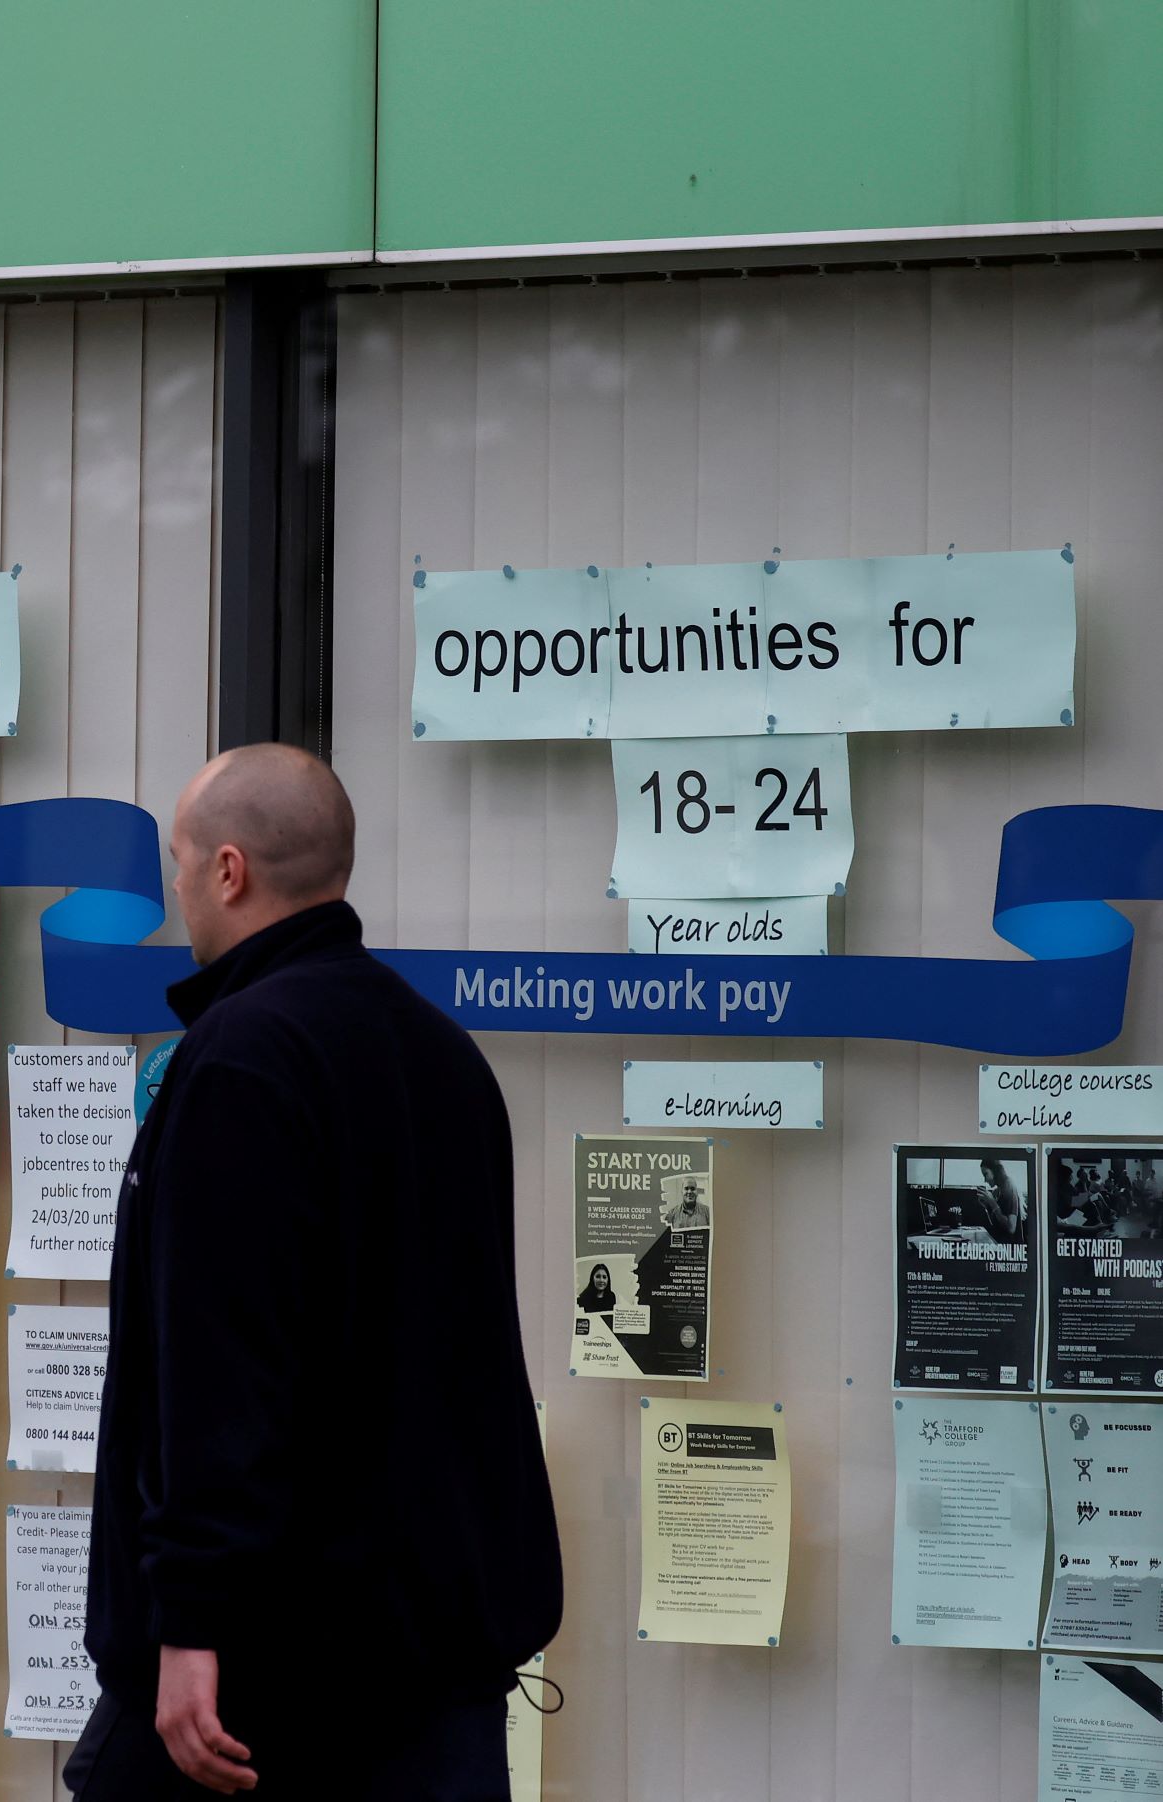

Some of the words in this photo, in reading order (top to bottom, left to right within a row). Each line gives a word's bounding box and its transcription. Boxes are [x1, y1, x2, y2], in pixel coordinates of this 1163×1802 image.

[435, 606, 839, 692] opportunities
[889, 601, 974, 666] for
[640, 769, 735, 835] 18-
[754, 767, 828, 831] 24
[647, 911, 720, 952] Year
[727, 910, 783, 943] olds
[454, 967, 595, 1020] Making
[608, 968, 706, 1010] work
[719, 978, 791, 1023] pay
[15, 1053, 83, 1066] customers
[87, 1051, 109, 1066] and
[113, 1054, 132, 1066] our
[33, 1078, 62, 1092] staff
[67, 1080, 85, 1092] we
[90, 1078, 116, 1092] have
[997, 1069, 1072, 1096] College
[1079, 1072, 1153, 1091] courses
[18, 1104, 54, 1118] taken
[58, 1105, 79, 1118] the
[83, 1105, 131, 1119] decision
[664, 1092, 782, 1126] e-learning
[997, 1105, 1072, 1127] on-line
[40, 1132, 53, 1144] to
[57, 1131, 88, 1145] close
[93, 1134, 113, 1145] our
[23, 1156, 89, 1173] jobcentres
[93, 1159, 105, 1172] to
[109, 1157, 127, 1172] the
[587, 1152, 642, 1169] START
[647, 1153, 691, 1171] YOUR
[587, 1173, 651, 1191] FUTURE
[41, 1184, 78, 1200] public
[82, 1184, 111, 1198] from
[32, 1209, 89, 1226] 24/03/20
[93, 1211, 116, 1224] unti
[31, 1235, 74, 1251] further
[78, 1236, 115, 1251] notice
[1057, 1239, 1076, 1257] GET
[1078, 1239, 1122, 1258] STARTED
[918, 1241, 955, 1259] FUTURE
[956, 1243, 996, 1261] LEADERS
[997, 1244, 1027, 1262] ONLINE
[1094, 1259, 1119, 1277] WITH
[1123, 1260, 1163, 1278] PODCAS
[26, 1331, 36, 1339] TO
[39, 1331, 64, 1340] CLAIM
[67, 1332, 109, 1342] UNIVERSA
[46, 1364, 69, 1375] 0800
[73, 1365, 90, 1376] 328
[26, 1390, 62, 1399] CITIZENS
[65, 1390, 94, 1400] ADVICE
[26, 1401, 43, 1411] Help
[45, 1402, 51, 1410] to
[54, 1402, 72, 1411] claim
[26, 1428, 48, 1439] 0800
[52, 1429, 68, 1440] 144
[72, 1430, 94, 1441] 8444
[944, 1425, 984, 1433] TRAFFORD
[664, 1432, 677, 1443] BT
[50, 1528, 78, 1539] Please
[17, 1581, 32, 1591] For
[35, 1581, 44, 1592] all
[47, 1583, 71, 1593] other
[61, 1656, 89, 1668] 253
